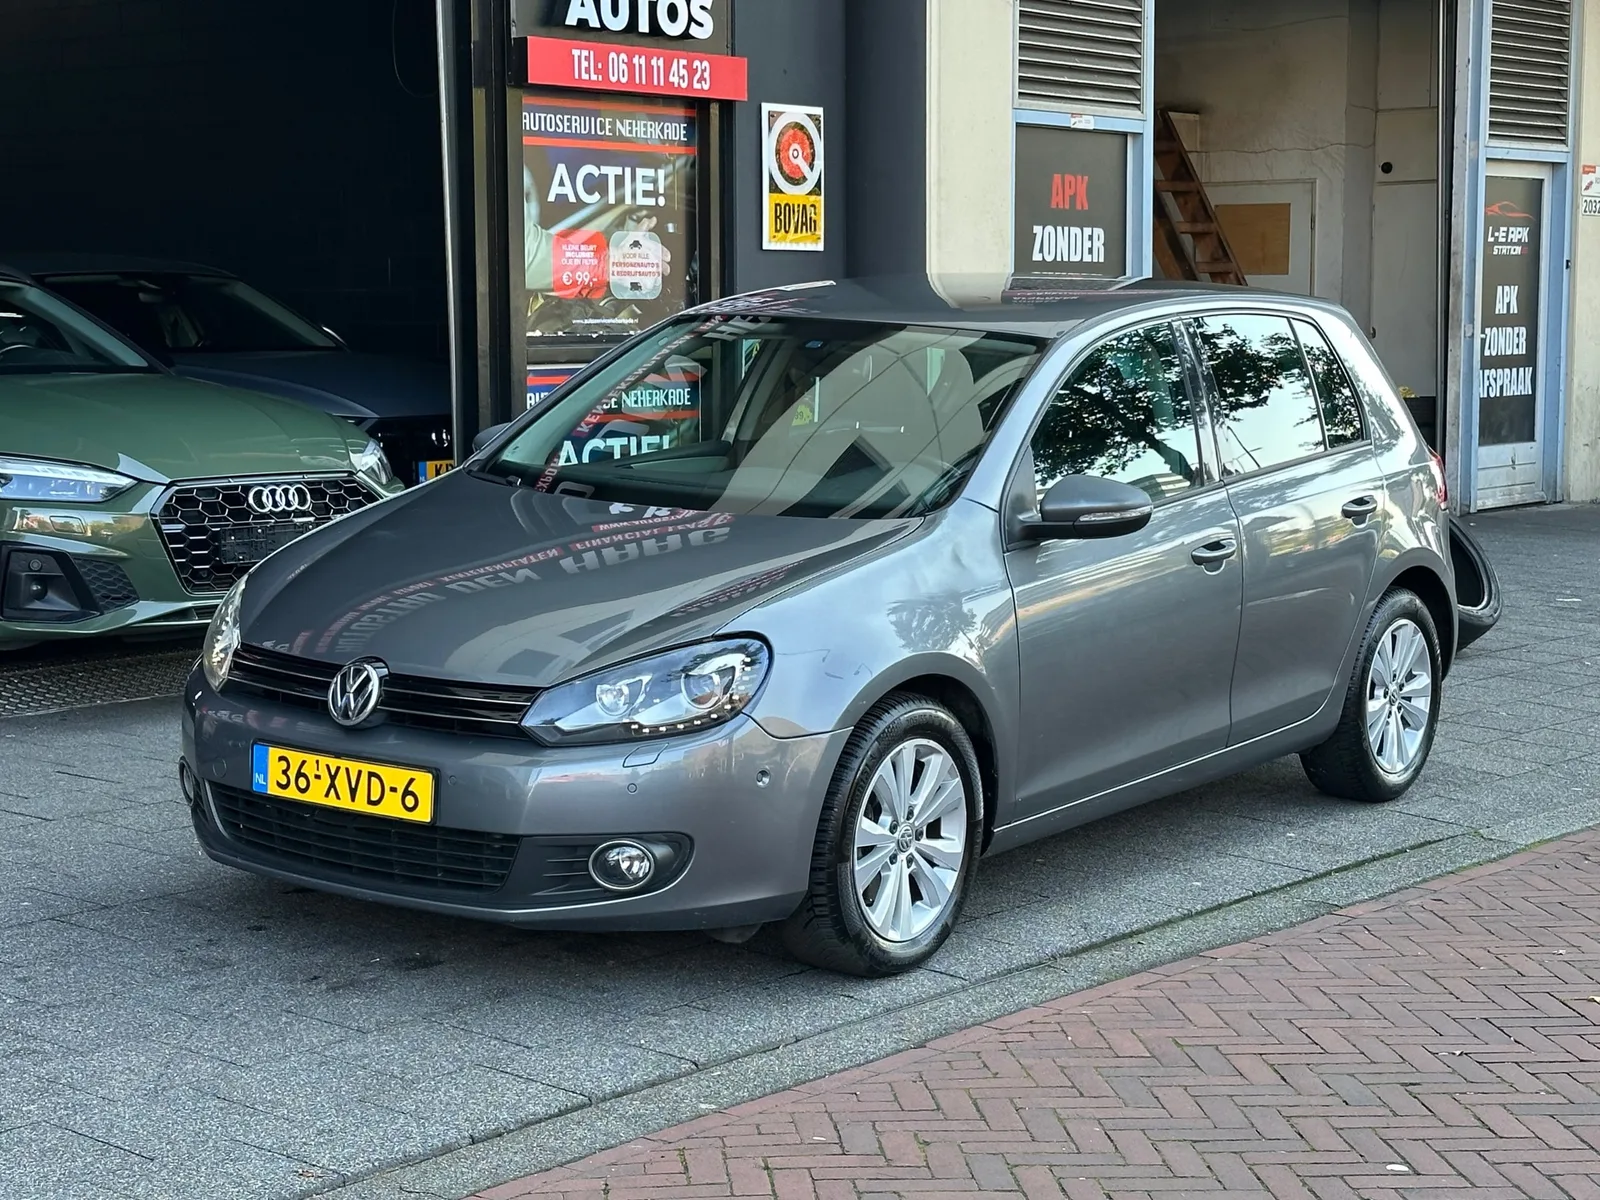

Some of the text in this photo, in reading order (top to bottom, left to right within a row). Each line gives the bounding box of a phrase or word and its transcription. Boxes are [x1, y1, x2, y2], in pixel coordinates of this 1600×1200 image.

[565, 0, 714, 39] AUTOS
[572, 49, 710, 91] TEL: 06 11 11 45 23
[523, 112, 688, 141] AUTOSERVICE NEHERKADE
[547, 163, 666, 207] ACTIE!
[1051, 173, 1089, 210] APK
[774, 202, 817, 234] BOVAG
[1032, 225, 1105, 262] ZONDER
[1493, 245, 1521, 255] STATION
[1495, 285, 1518, 314] APK
[1484, 326, 1527, 356] ZONDER
[622, 388, 691, 408] NEHERKADE
[255, 773, 267, 785] NL
[276, 755, 420, 813] 36-XVD-6
